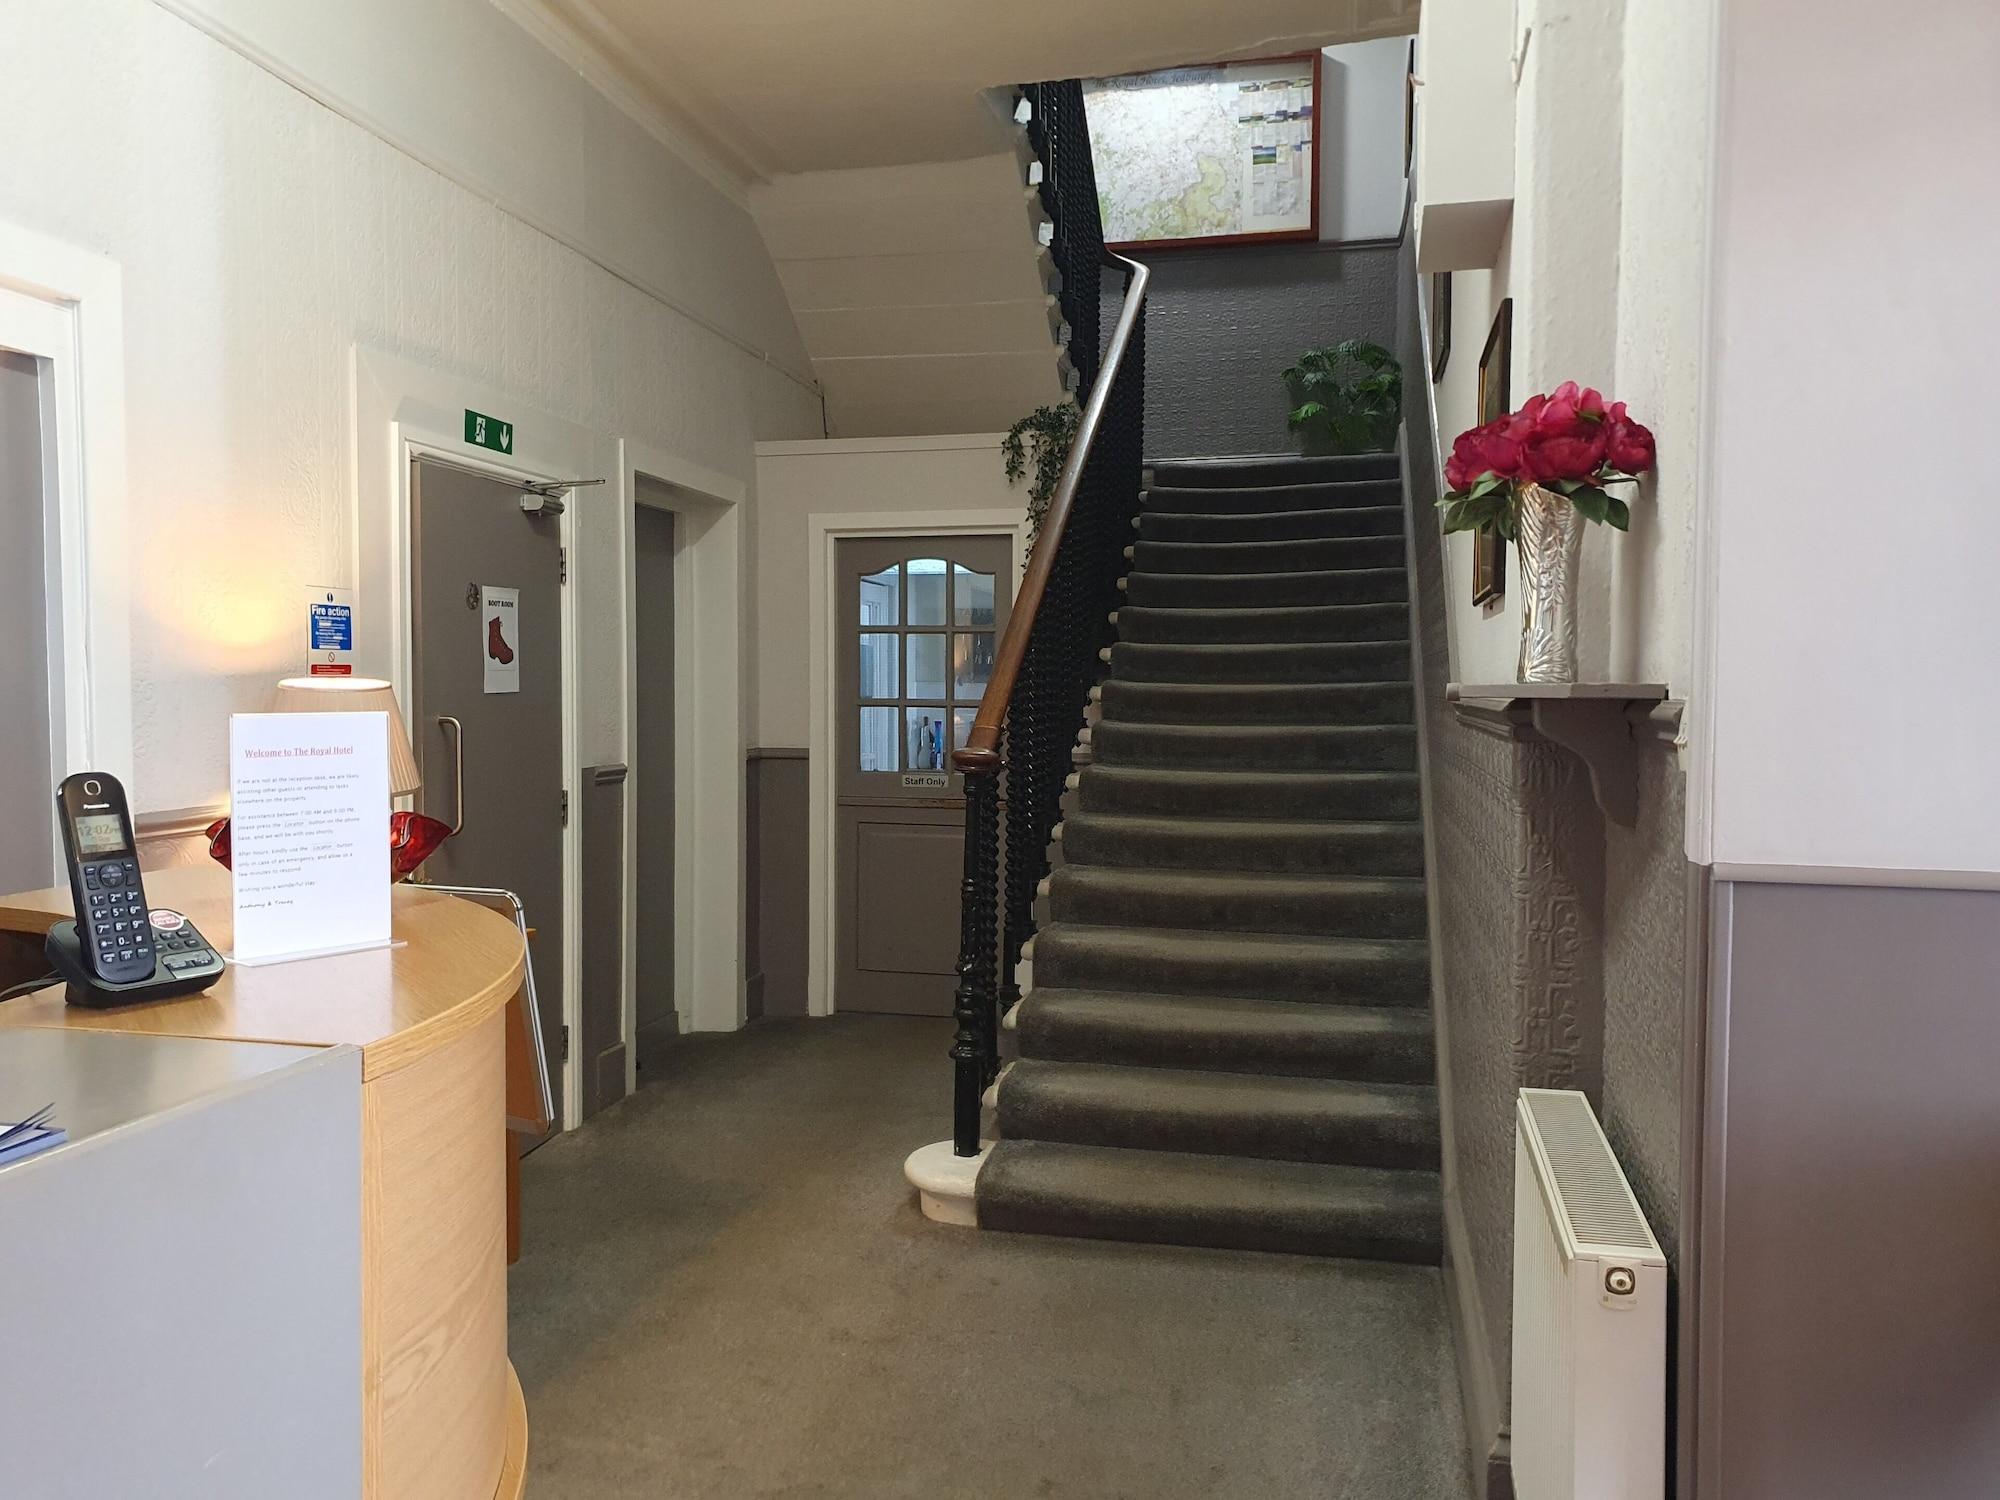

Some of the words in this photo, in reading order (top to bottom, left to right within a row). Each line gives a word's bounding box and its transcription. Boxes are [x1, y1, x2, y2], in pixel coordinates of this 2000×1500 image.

[311, 605, 326, 615] Fire
[327, 607, 349, 617] action
[245, 749, 282, 758] Welcome
[284, 749, 291, 757] to
[294, 747, 308, 756] The
[310, 746, 331, 756] Royal
[333, 745, 353, 755] Hotel
[905, 777, 924, 785] Staff
[926, 777, 946, 787] Only
